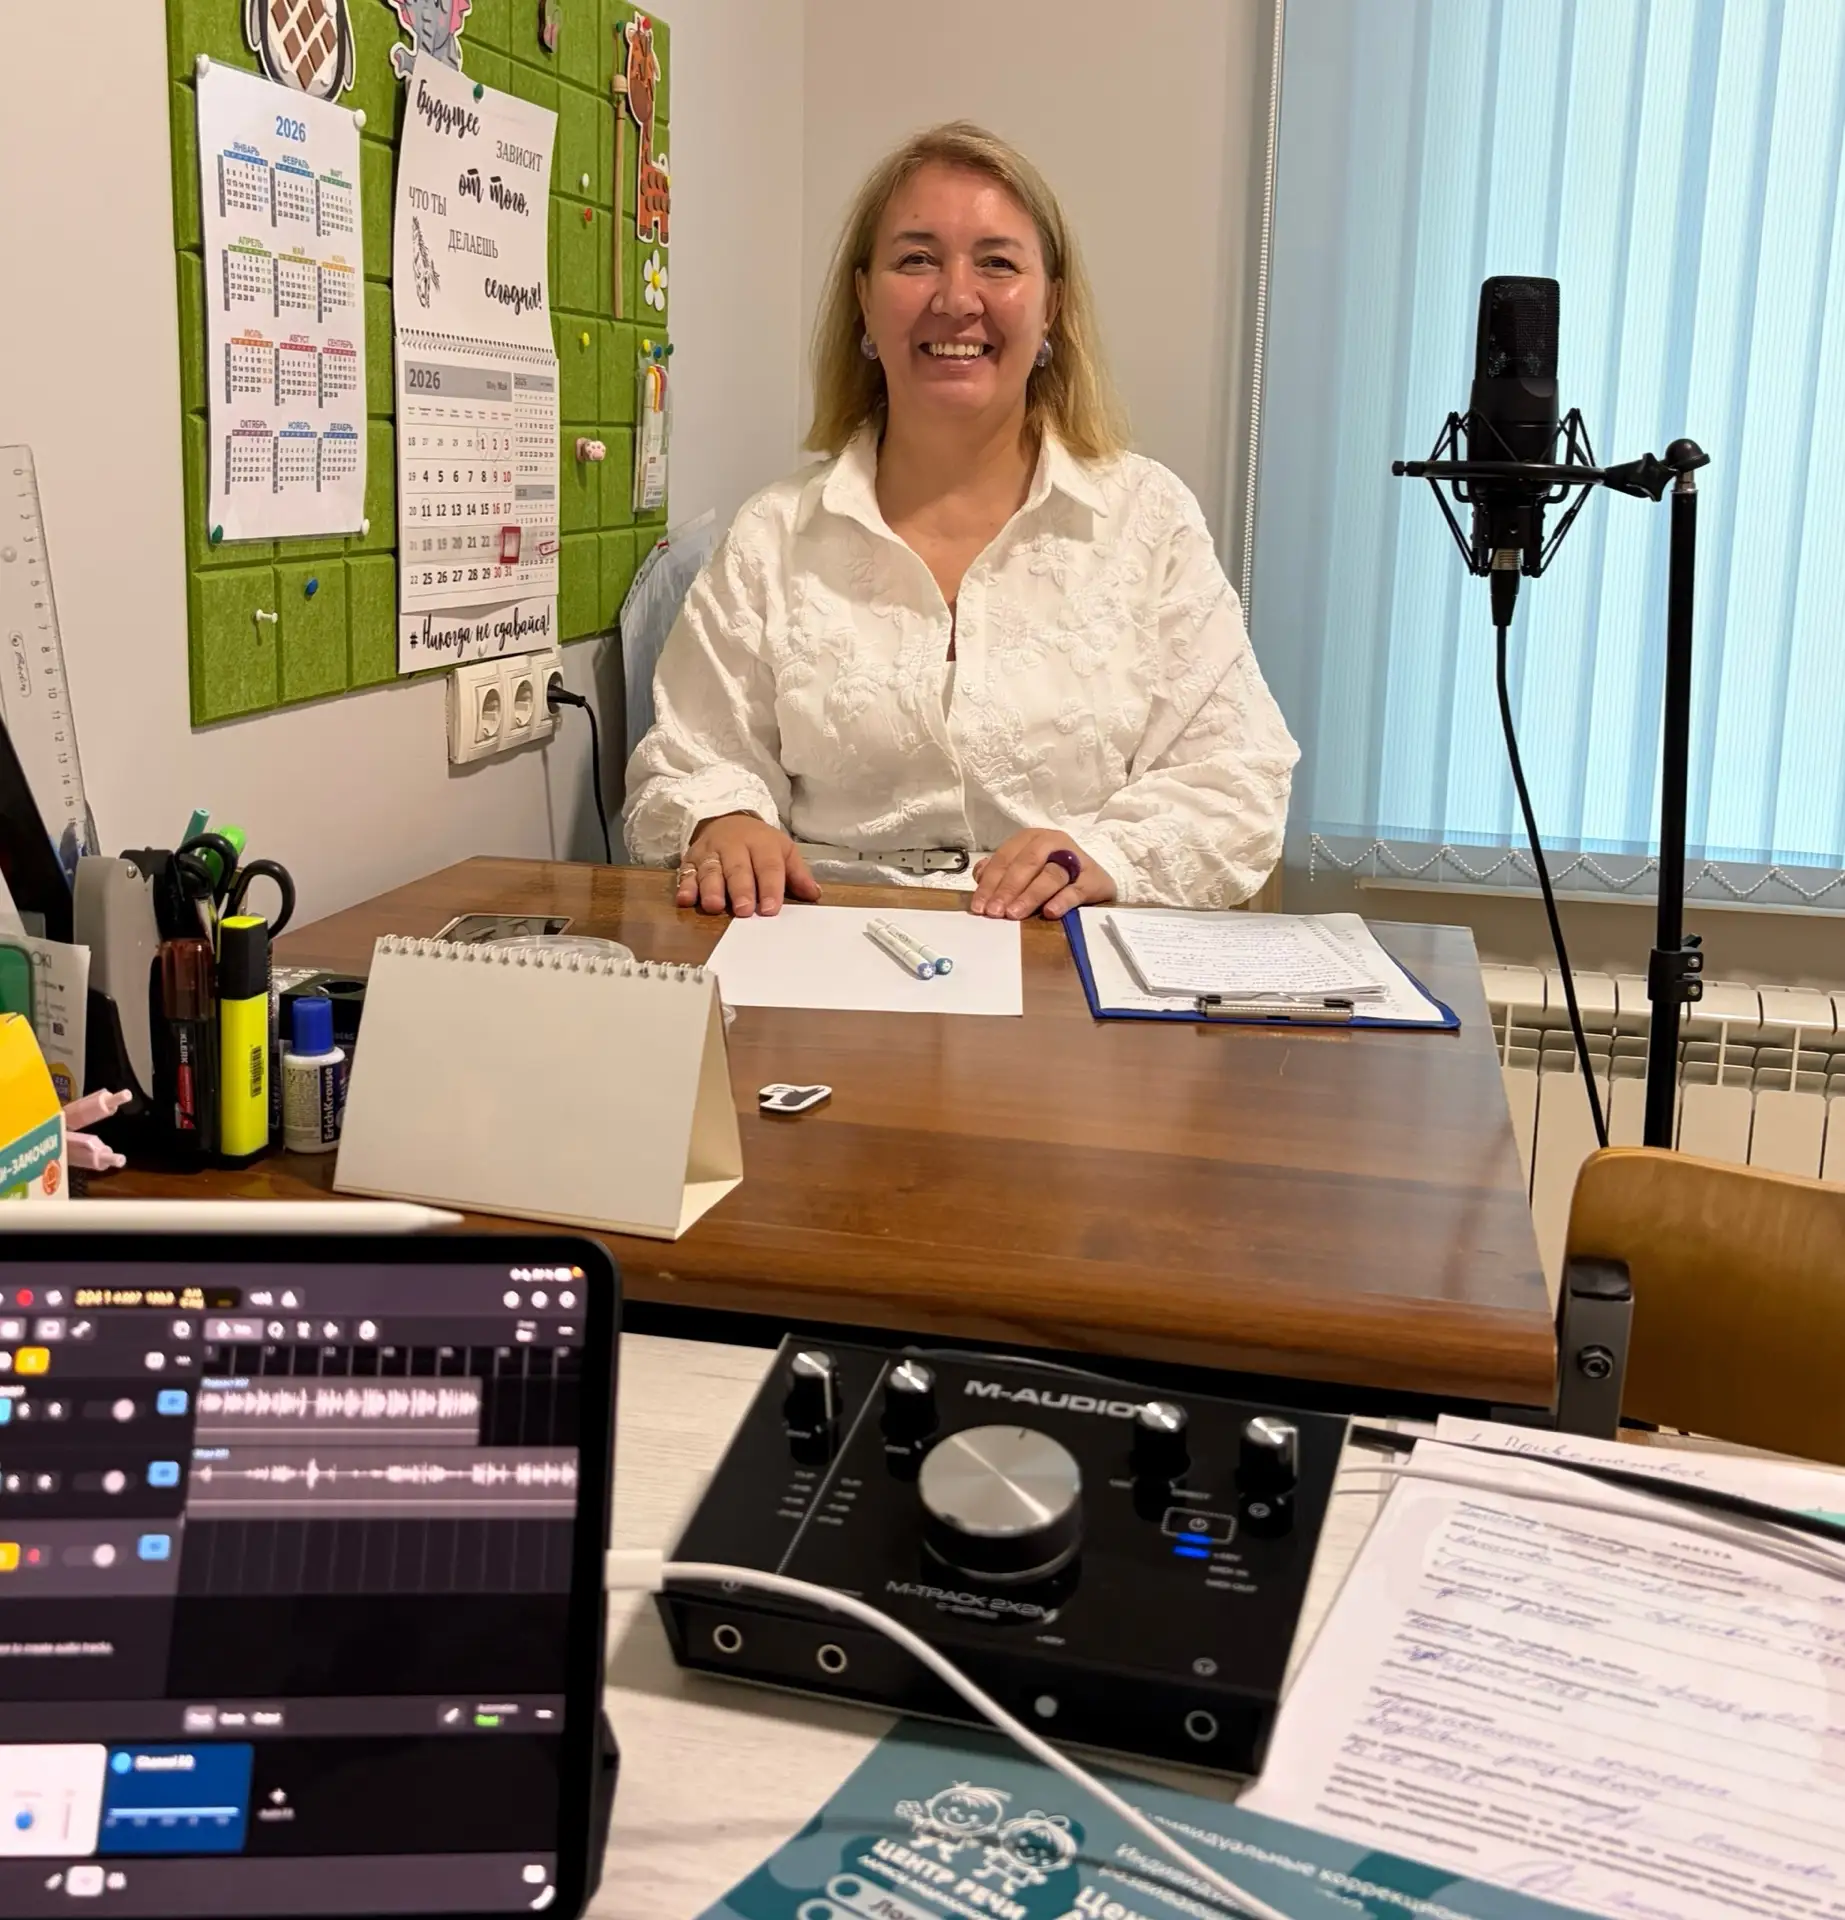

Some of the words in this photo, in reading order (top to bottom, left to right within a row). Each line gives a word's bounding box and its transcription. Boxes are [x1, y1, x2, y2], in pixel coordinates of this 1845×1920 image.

[416, 79, 480, 139] Будущее
[276, 115, 306, 142] 2026
[496, 140, 543, 172] ЗАВИСИТ
[409, 185, 429, 211] ЧТО
[431, 192, 447, 216] ТЫ
[458, 168, 484, 204] от
[489, 176, 530, 216] того,
[238, 236, 263, 249] АПРЕЛЬ
[448, 229, 499, 259] ДЕЛАЕШЬ
[484, 277, 543, 315] сегодня!
[289, 334, 309, 343] АВГУСТ
[408, 368, 441, 390] 2026
[240, 419, 267, 429] ОКТЯБРЬ
[408, 437, 415, 446] 18
[492, 438, 497, 450] 2
[504, 439, 509, 451] 3
[423, 470, 428, 482] 4
[438, 470, 443, 482] 5
[453, 470, 459, 482] 6
[468, 470, 473, 482] 7
[481, 470, 486, 482] 8
[493, 471, 498, 482] 9
[503, 471, 511, 482] 10
[409, 506, 417, 516] 20
[421, 504, 431, 517] 11
[436, 504, 446, 516] 12
[452, 503, 461, 516] 13
[467, 503, 476, 516] 14
[481, 503, 489, 515] 15
[492, 502, 500, 514] 16
[503, 502, 511, 514] 17
[437, 537, 447, 550] 19
[452, 536, 462, 549] 20
[467, 536, 476, 548] 21
[481, 535, 490, 547] 22
[410, 575, 418, 584] 22
[422, 572, 433, 585] 25
[437, 571, 447, 583] 26
[452, 570, 462, 582] 27
[468, 568, 478, 581] 28
[482, 567, 491, 579] 29
[494, 566, 502, 578] 30
[504, 565, 512, 577] 31
[422, 613, 472, 658] Никогда
[476, 623, 491, 641] не
[494, 604, 550, 651] сдавайся!
[48, 687, 57, 699] 10
[52, 710, 61, 720] 11
[55, 731, 64, 742] 12
[58, 753, 67, 764] 13
[61, 774, 71, 785] 14
[323, 1067, 334, 1141] ErichKrause
[964, 1379, 1137, 1419] M-AUDIO
[885, 1580, 988, 1608] M-TRACK
[872, 1838, 956, 1882] ЦЕНТР
[953, 1878, 1028, 1919] РЕЧИ
